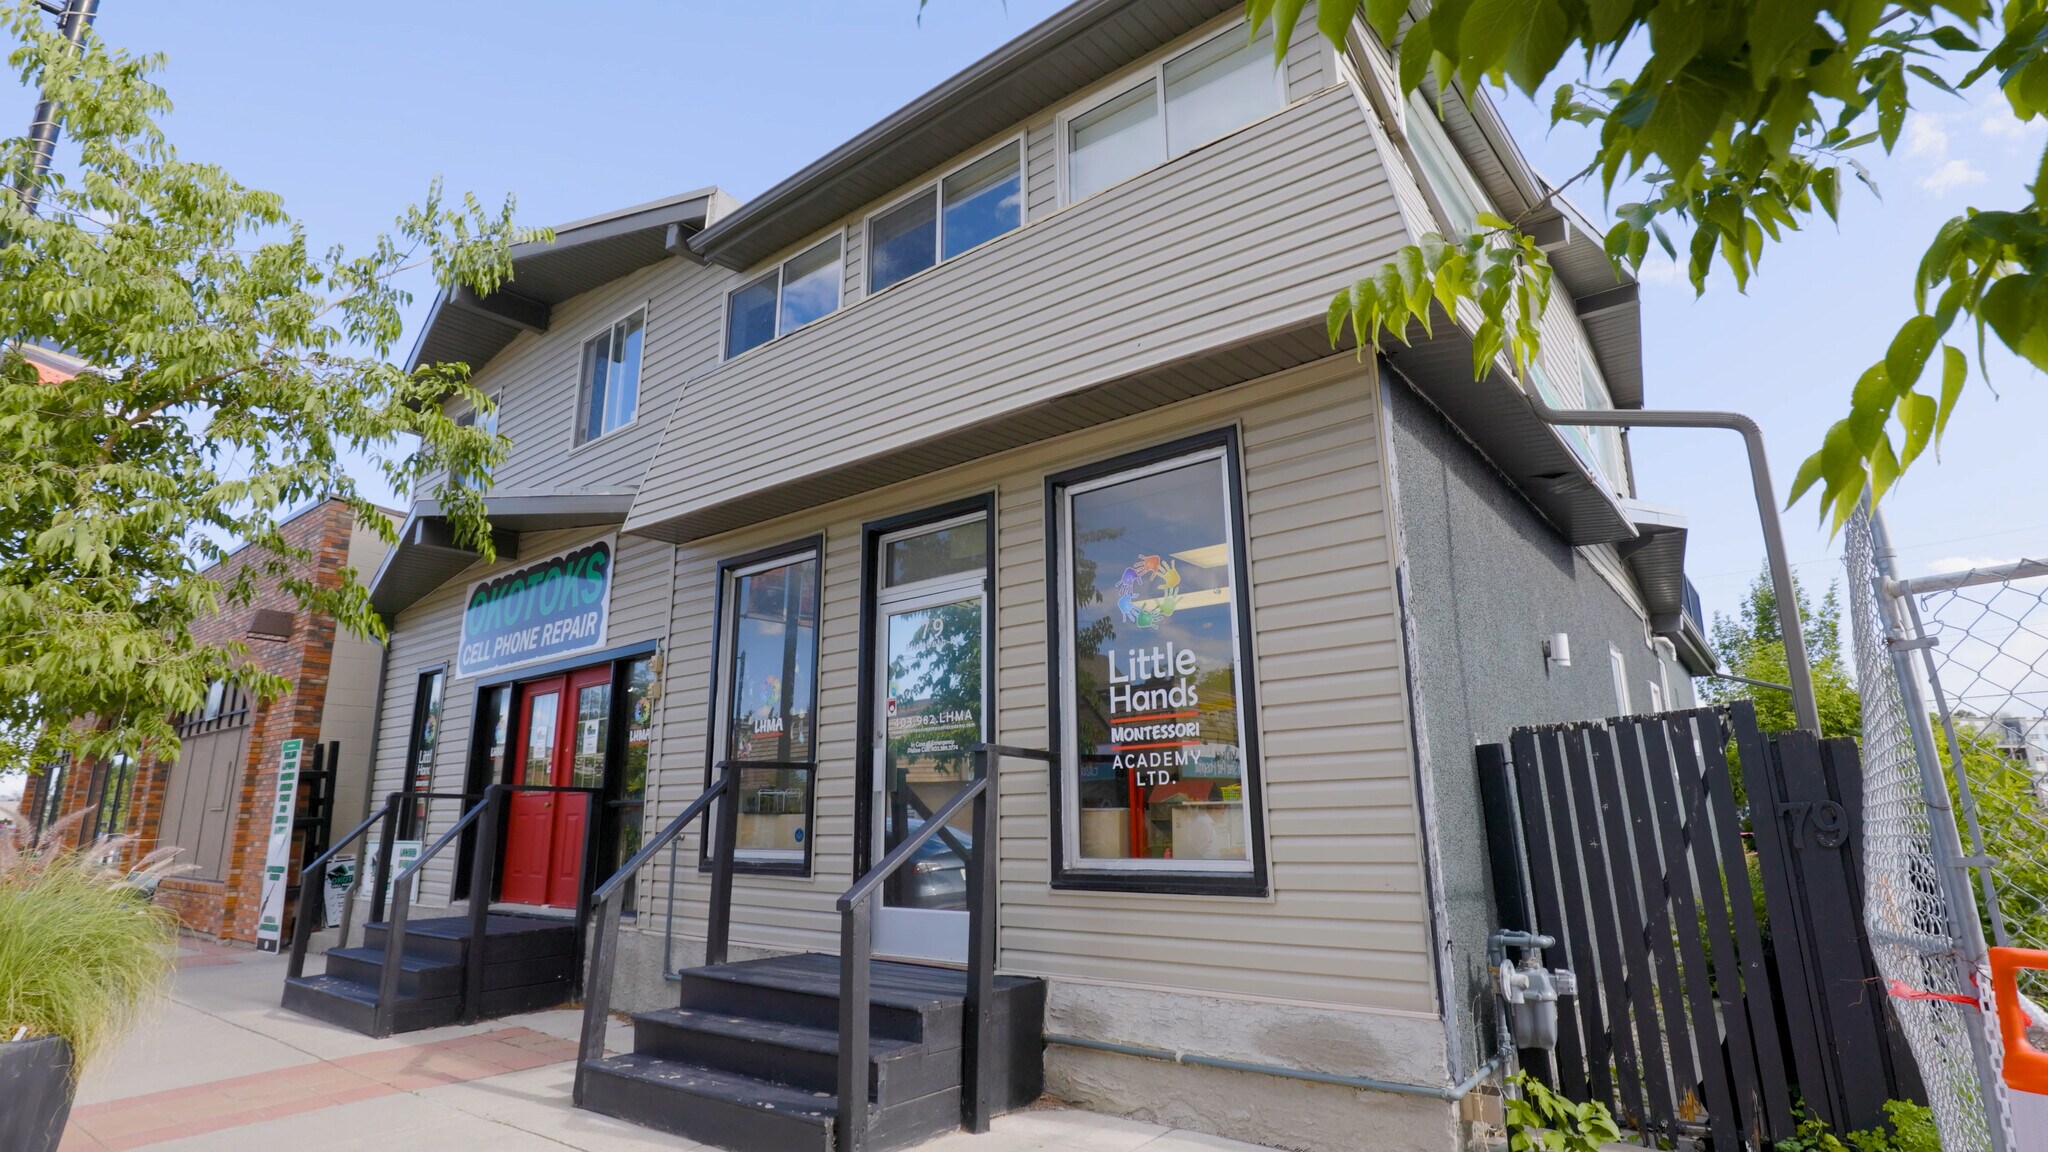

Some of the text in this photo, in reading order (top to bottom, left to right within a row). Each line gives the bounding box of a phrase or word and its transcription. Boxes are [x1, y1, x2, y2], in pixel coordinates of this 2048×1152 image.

[467, 550, 606, 637] OKOTOKS
[462, 611, 598, 666] CELL PHONE REPAIR
[1108, 641, 1197, 684] Little
[1109, 677, 1199, 714] Hands
[754, 717, 784, 734] LHMA
[1111, 722, 1200, 743] MONTESSORI
[1112, 750, 1201, 770] ACADEMY
[1136, 770, 1177, 787] LTD.
[1776, 800, 1849, 849] 79
